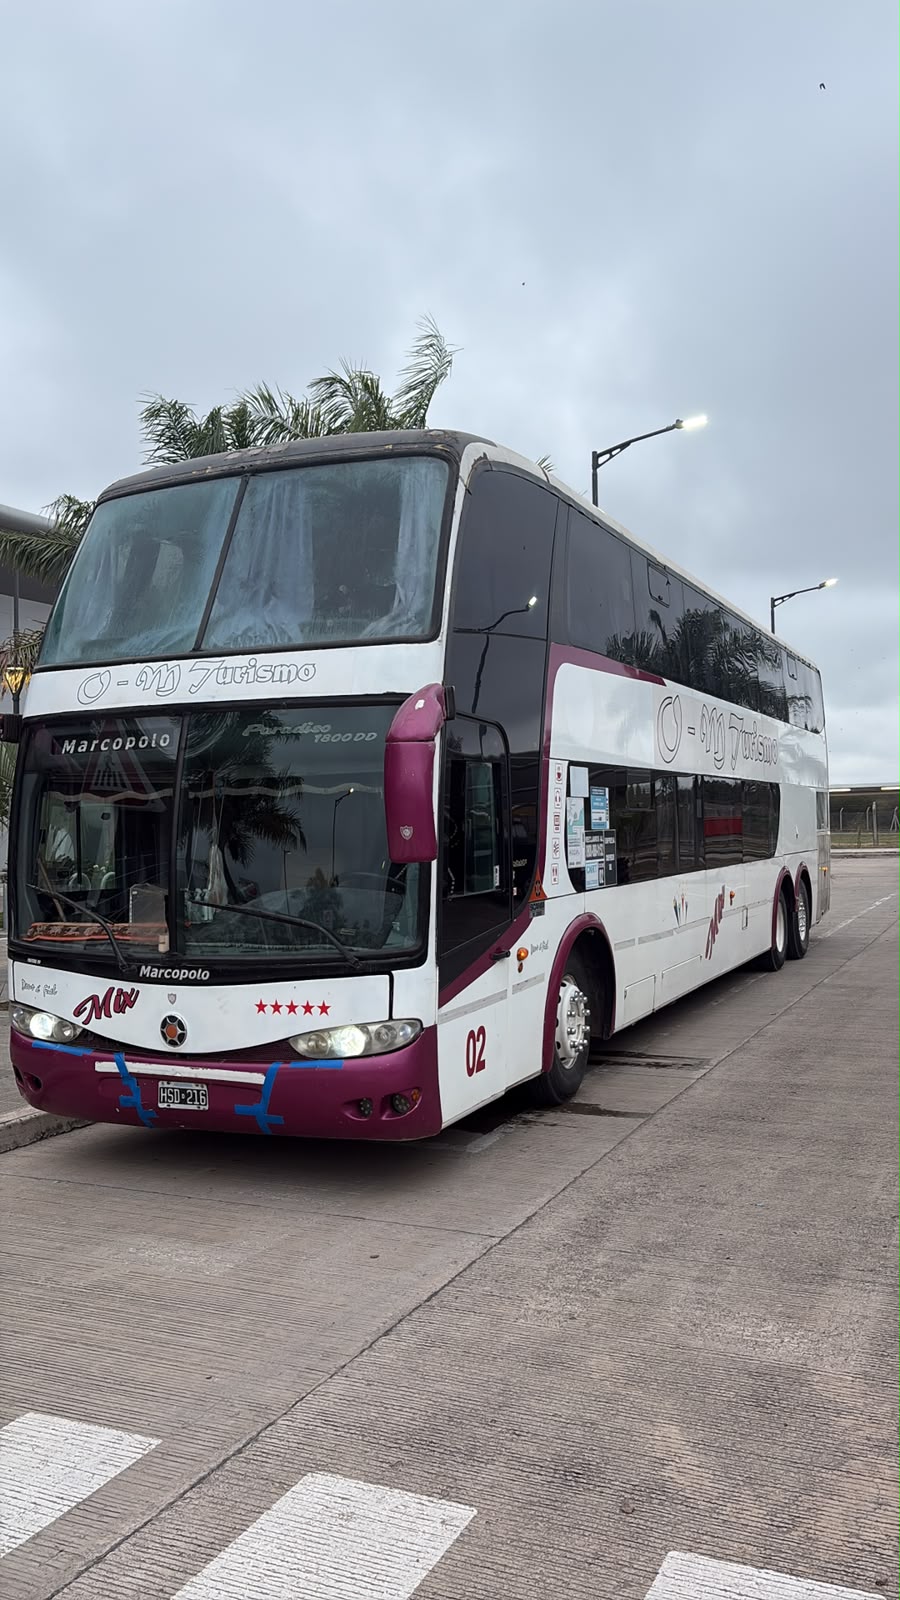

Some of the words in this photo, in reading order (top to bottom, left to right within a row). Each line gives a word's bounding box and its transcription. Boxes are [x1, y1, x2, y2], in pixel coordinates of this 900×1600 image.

[188, 658, 316, 694] Turismo
[242, 721, 331, 737] Paradiso
[314, 732, 377, 743] 1800DD
[728, 712, 778, 771] Turismo
[61, 733, 170, 754] Marcopolo
[139, 965, 210, 980] Marcopolo
[73, 986, 140, 1025] Mix
[466, 1025, 486, 1077] 02
